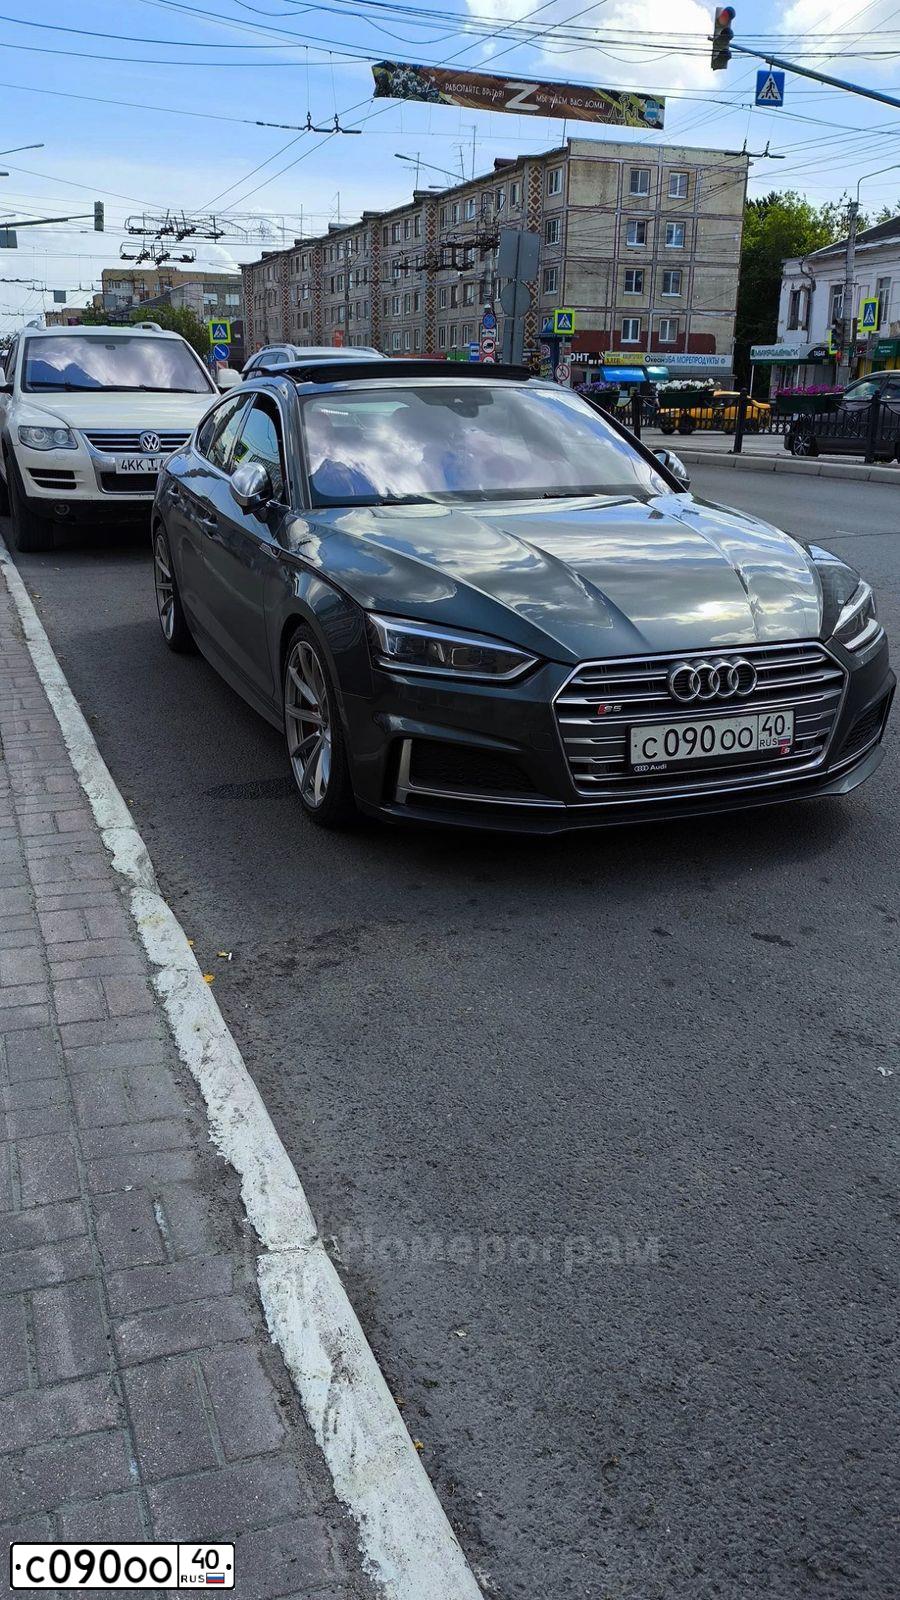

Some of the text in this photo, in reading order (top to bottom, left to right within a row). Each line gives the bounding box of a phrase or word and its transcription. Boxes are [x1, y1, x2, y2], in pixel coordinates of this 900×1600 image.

[504, 82, 540, 111] Z
[570, 98, 583, 107] ВАС
[585, 100, 605, 110] ДОМА!
[677, 356, 719, 365] МОРЕПРОДУКТЫ
[761, 714, 785, 737] 40
[759, 738, 778, 748] RUS
[650, 763, 667, 771] Audi
